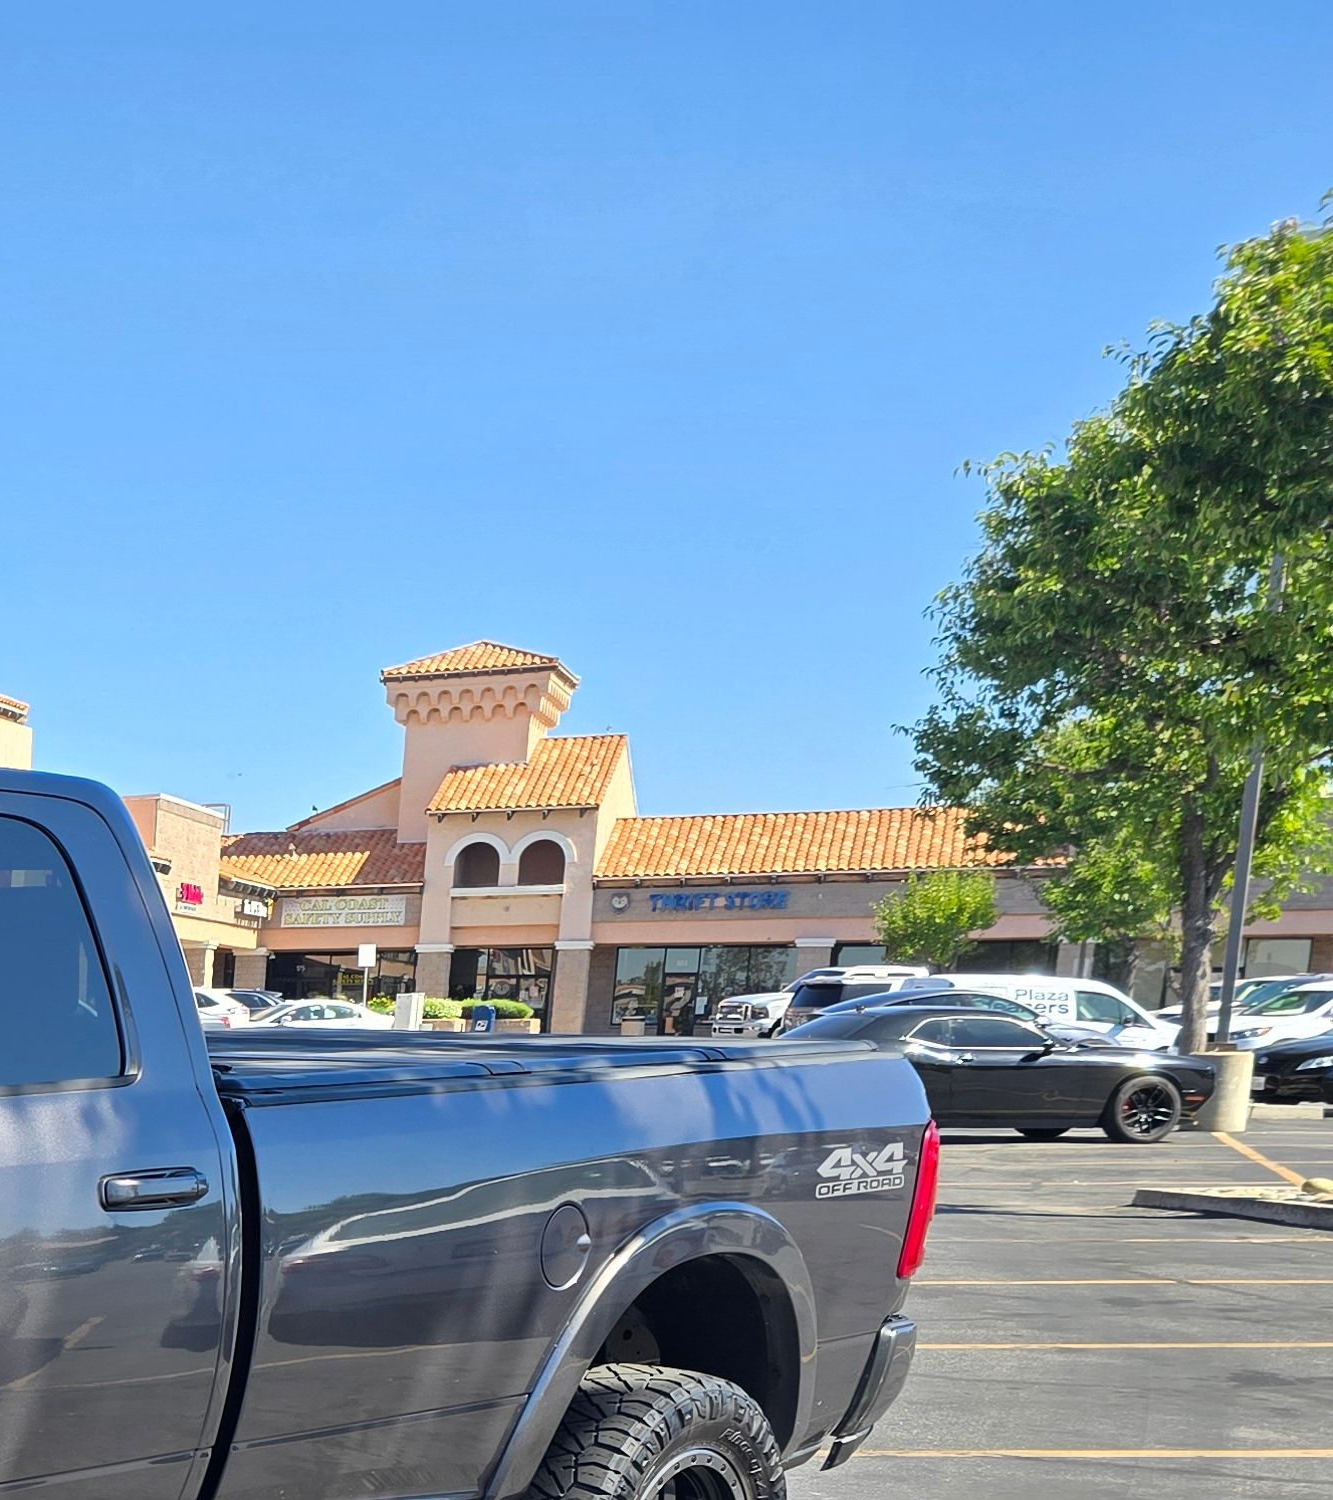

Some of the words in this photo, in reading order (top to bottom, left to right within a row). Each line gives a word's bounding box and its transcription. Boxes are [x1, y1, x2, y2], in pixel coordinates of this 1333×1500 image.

[299, 898, 332, 911] CAL
[335, 897, 389, 910] COAST
[649, 892, 719, 912] THRIFT
[724, 890, 790, 911] STORE
[284, 912, 342, 926] SAFETY
[344, 911, 403, 924] SUPPLY
[1014, 989, 1069, 1001] Plaza
[818, 1182, 854, 1196] OFF
[857, 1176, 903, 1191] ROAD
